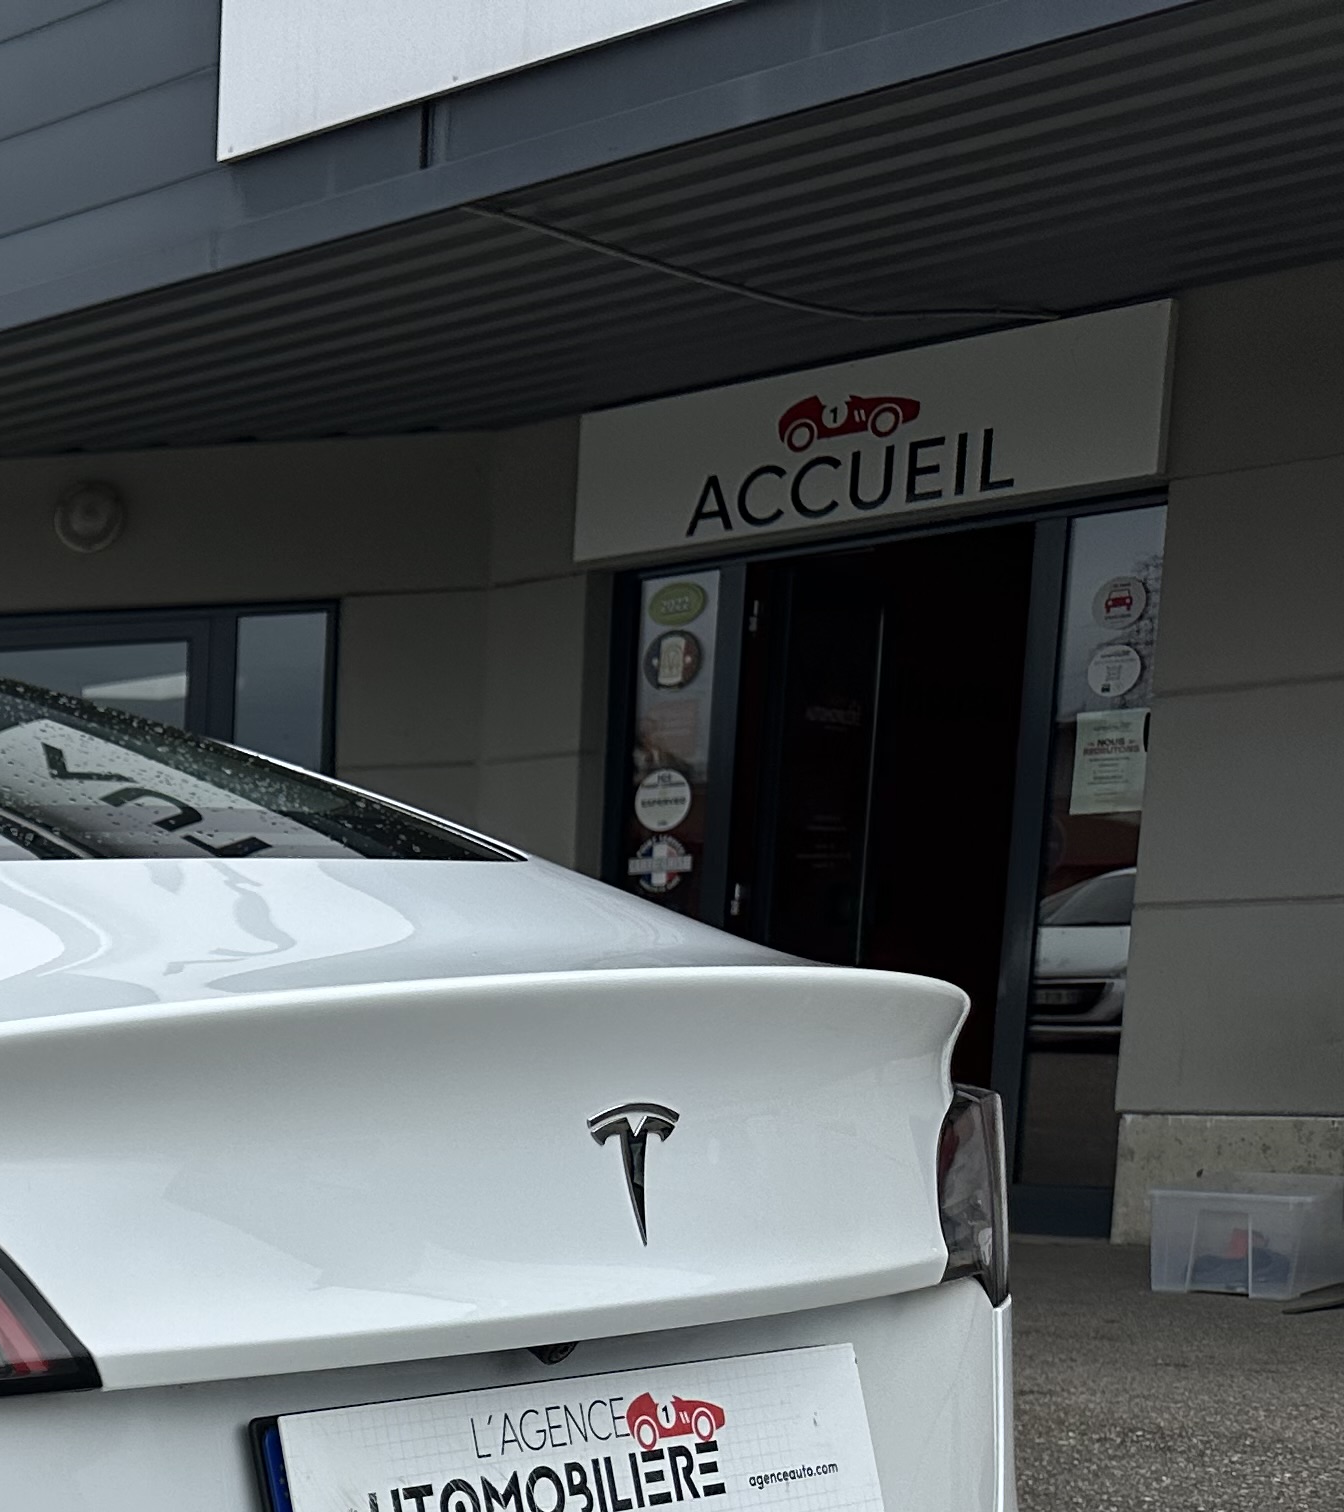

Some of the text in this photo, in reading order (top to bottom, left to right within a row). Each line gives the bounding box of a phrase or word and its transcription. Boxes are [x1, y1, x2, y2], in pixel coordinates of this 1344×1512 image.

[829, 406, 839, 424] 1
[685, 427, 1015, 538] ACCUEIL
[470, 1396, 631, 1459] L'AGENCE
[661, 1405, 670, 1424] 1
[748, 1461, 839, 1490] agenceauto.com
